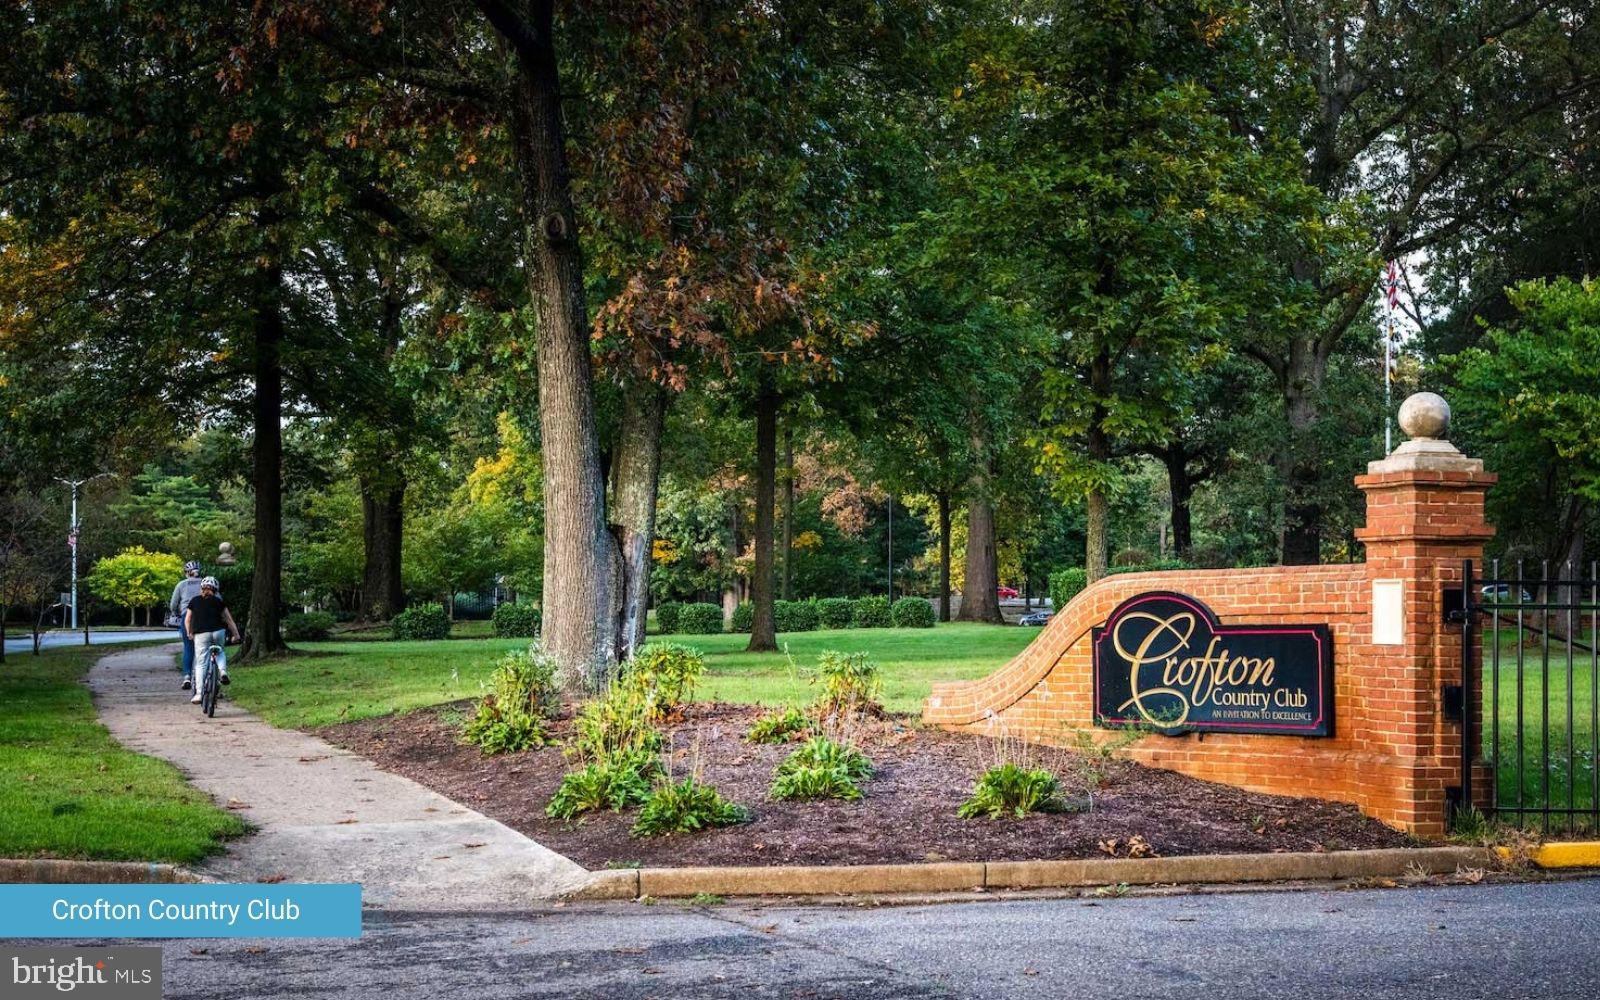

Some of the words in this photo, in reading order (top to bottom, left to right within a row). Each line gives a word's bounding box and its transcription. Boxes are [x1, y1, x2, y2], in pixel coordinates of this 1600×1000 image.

[1113, 611, 1275, 728] Crofton
[1211, 687, 1271, 711] Country
[1274, 688, 1308, 708] Club
[1212, 709, 1222, 718] AN
[1223, 710, 1260, 719] INVITATION
[1261, 711, 1271, 720] TO
[1272, 711, 1312, 721] EXCELLENCE
